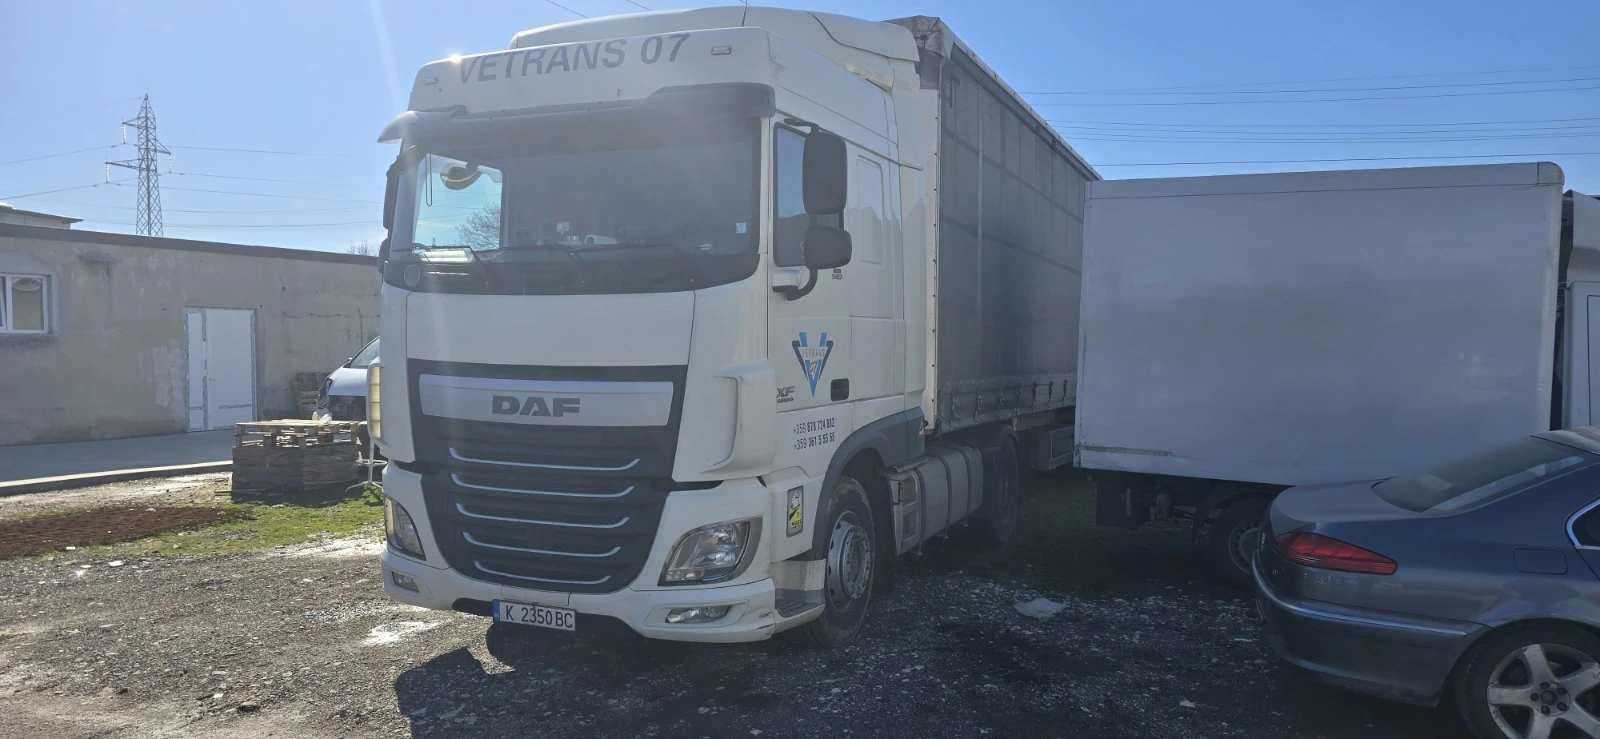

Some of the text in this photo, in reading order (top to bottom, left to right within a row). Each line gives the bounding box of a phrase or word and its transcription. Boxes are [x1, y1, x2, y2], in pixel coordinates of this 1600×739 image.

[459, 33, 690, 83] VETRANS 07
[776, 386, 795, 398] XF
[492, 395, 580, 417] DAF
[505, 605, 573, 628] K 2350 BC
